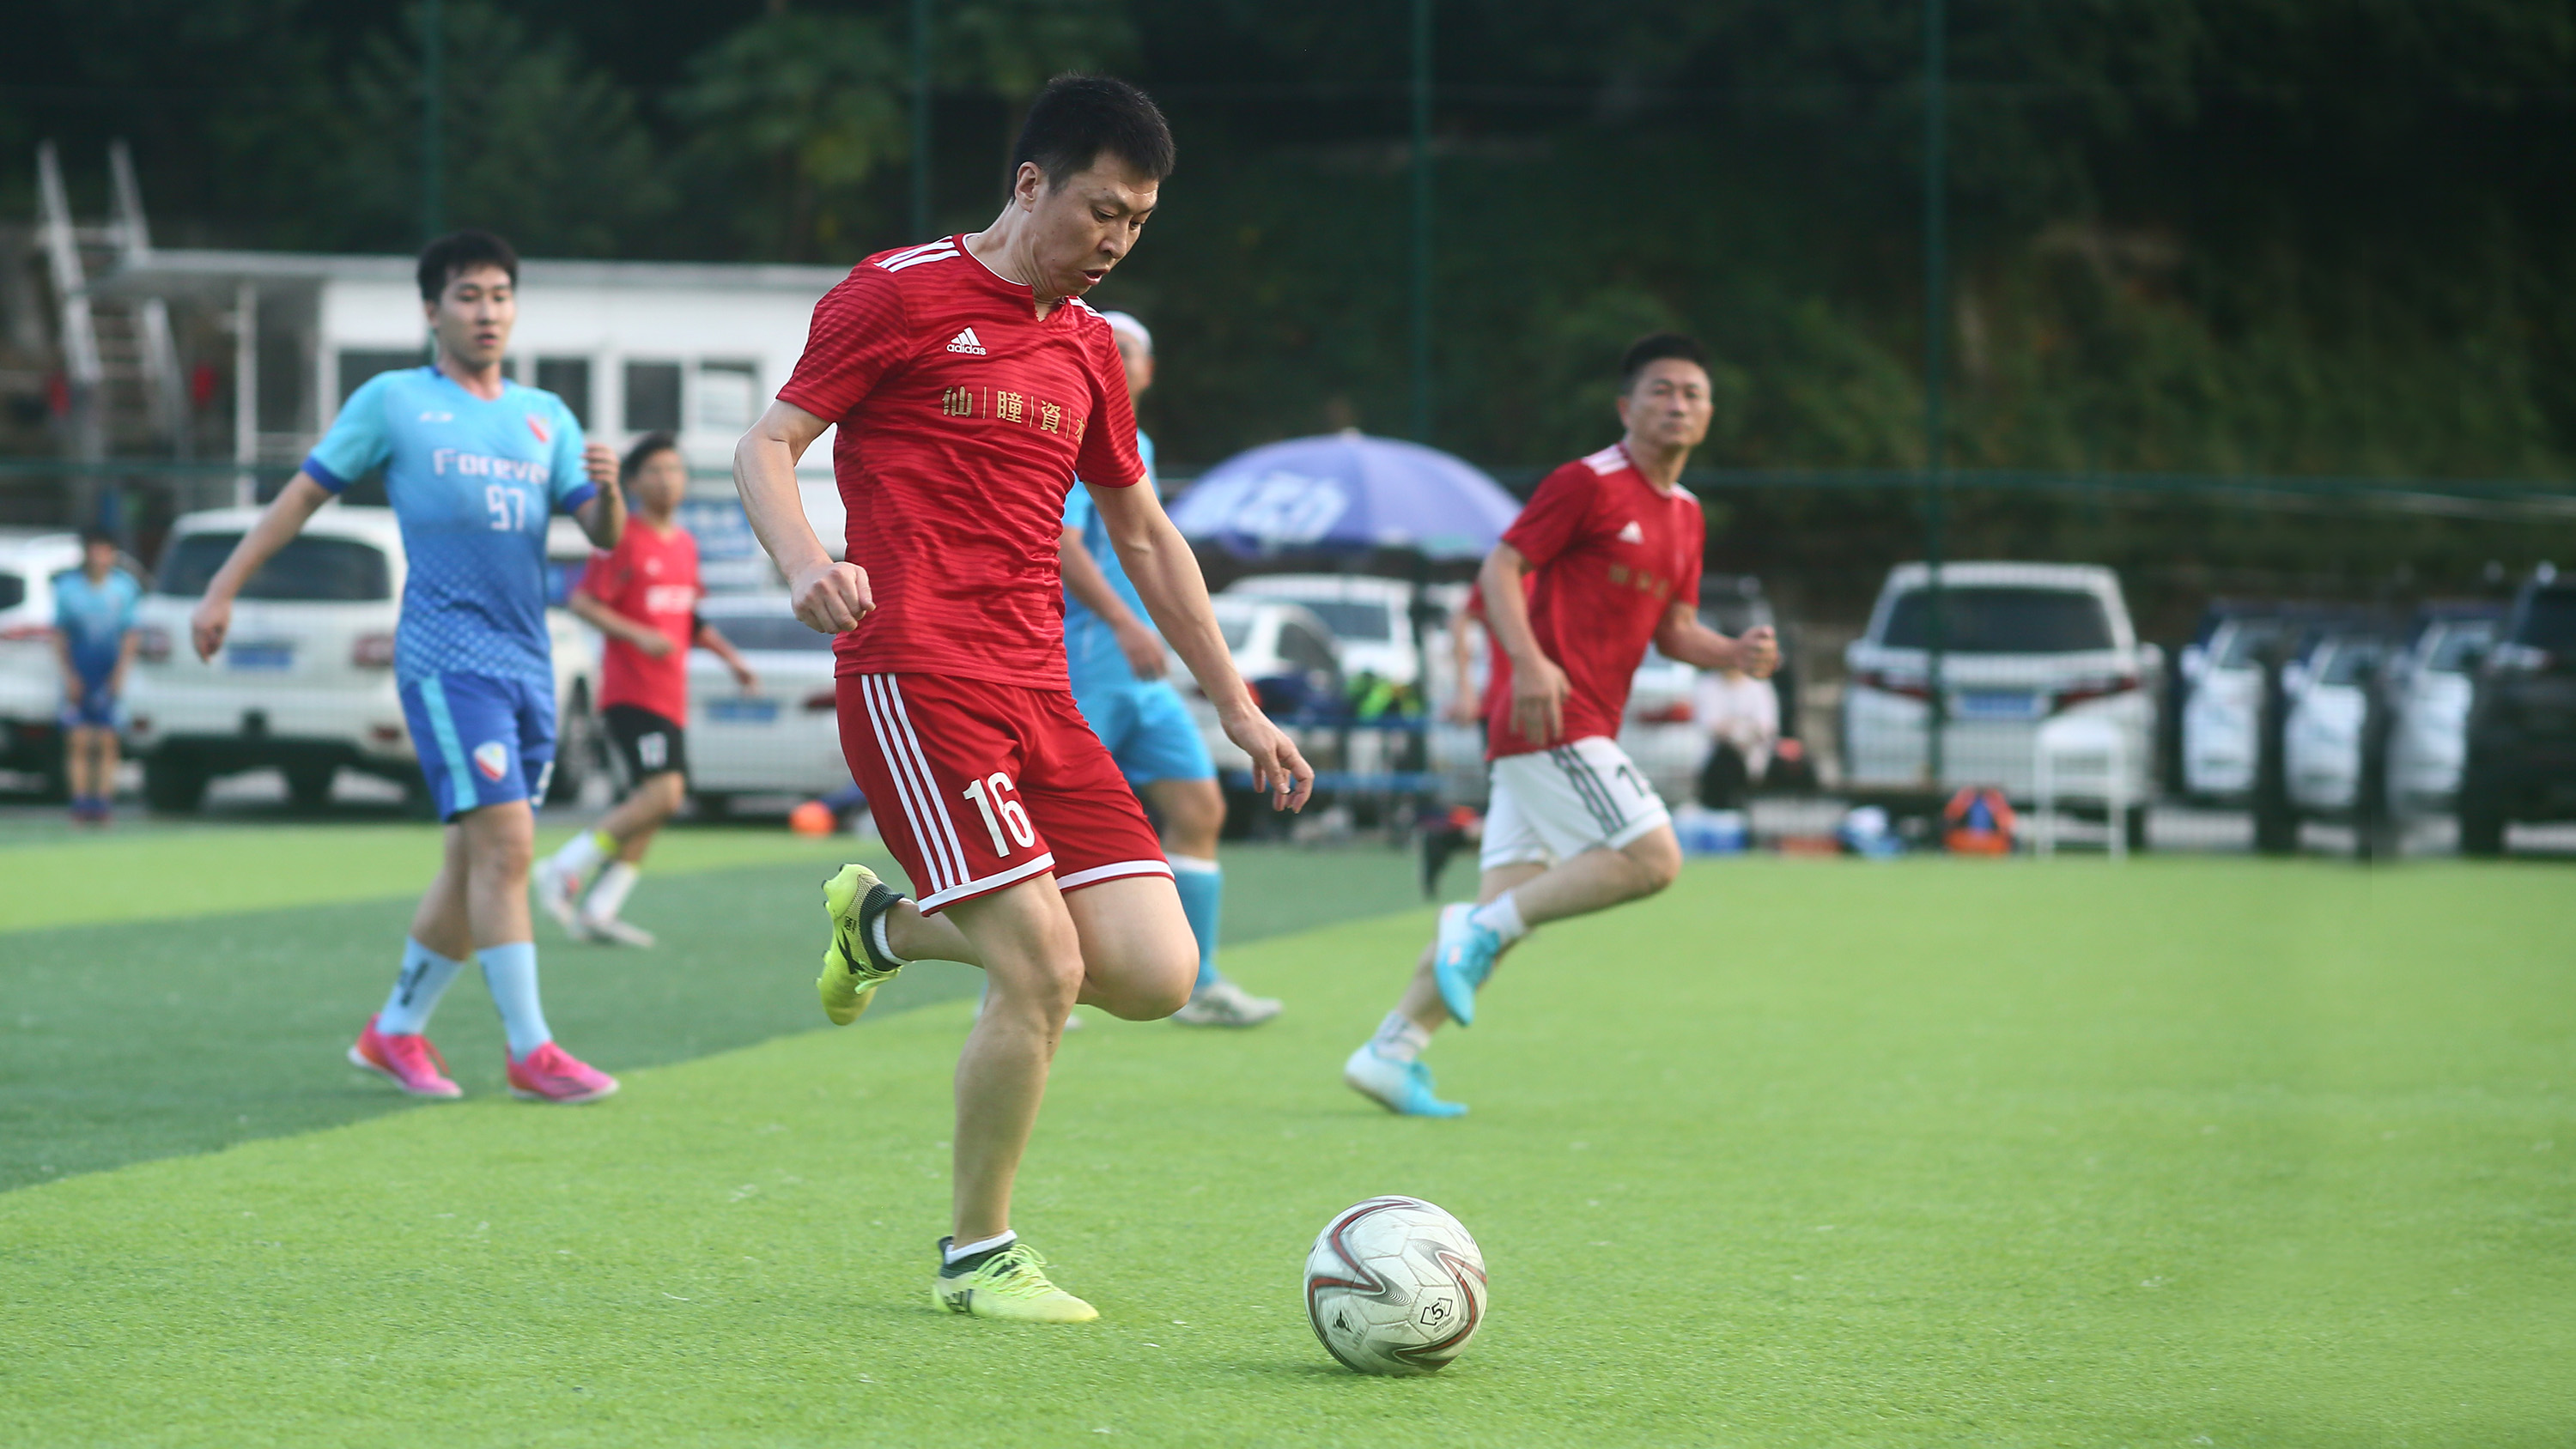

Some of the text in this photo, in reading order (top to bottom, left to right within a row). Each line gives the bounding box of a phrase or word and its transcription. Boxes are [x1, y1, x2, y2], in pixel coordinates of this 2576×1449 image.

[946, 344, 987, 355] adidas
[486, 484, 525, 530] 97
[963, 772, 1036, 858] 16
[1431, 1302, 1444, 1320] 5
